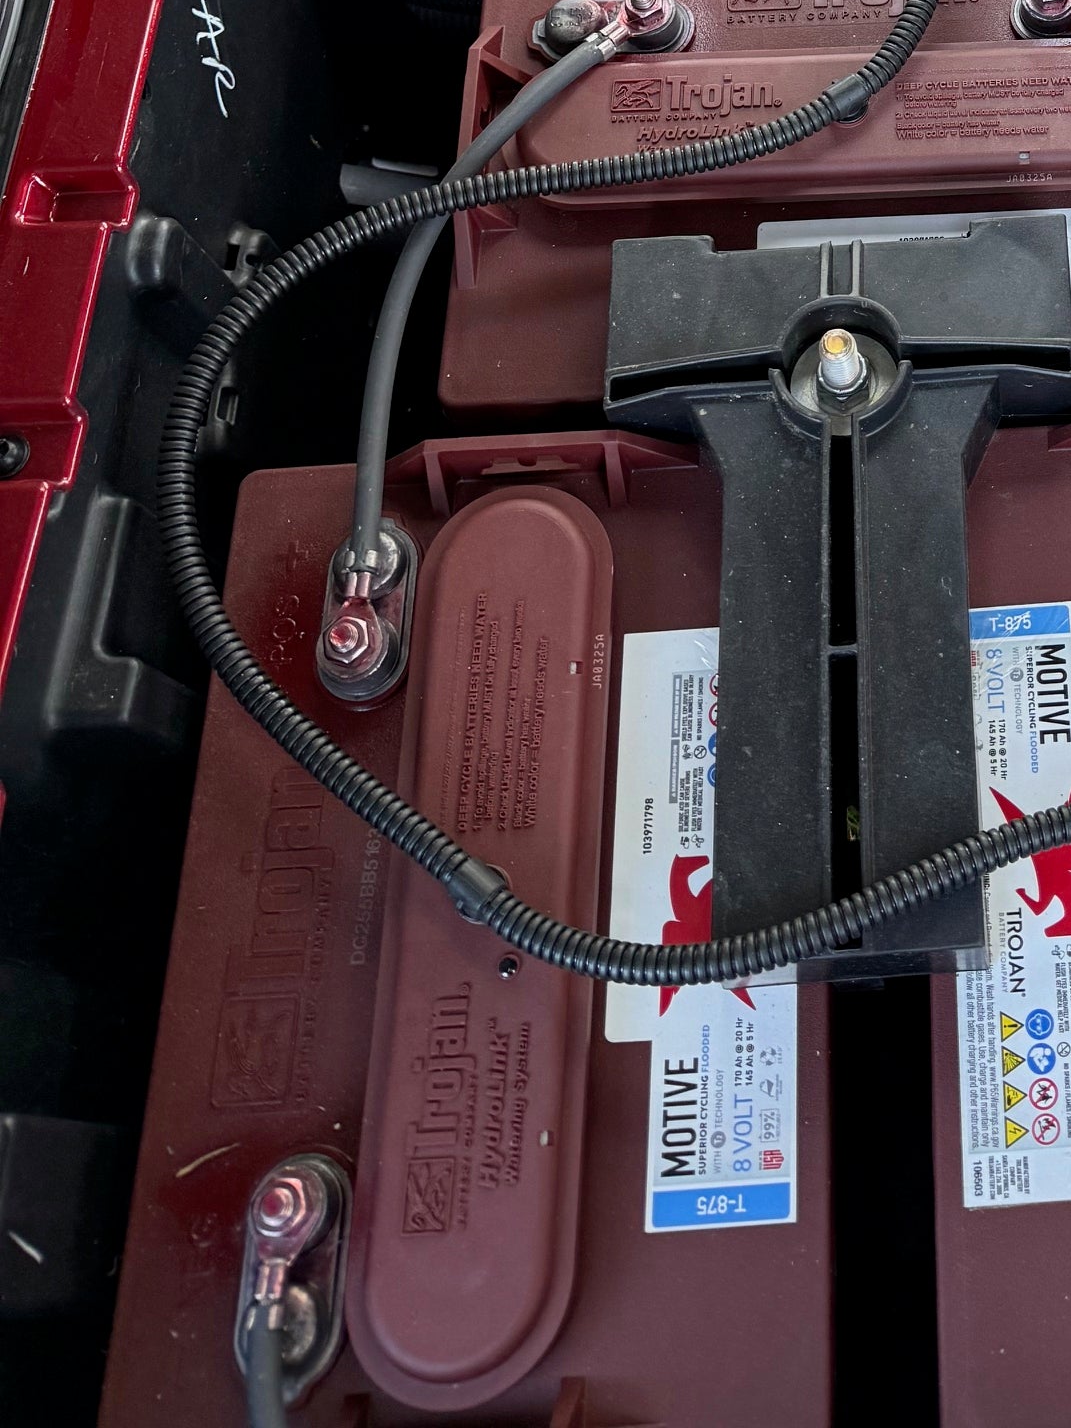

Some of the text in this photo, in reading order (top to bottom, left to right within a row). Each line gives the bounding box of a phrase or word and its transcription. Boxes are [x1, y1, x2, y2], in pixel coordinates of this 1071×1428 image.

[727, 10, 884, 25] BATTERY COMPANY
[666, 73, 773, 116] Trojan
[896, 82, 922, 91] DEEP
[926, 81, 959, 89] CYCLE
[963, 79, 1018, 88] BATTERIES
[1021, 77, 1047, 87] NEED
[610, 113, 717, 123] BATTERY COMPANY
[897, 127, 1050, 140] White color battery needs water
[269, 594, 299, 666] POS
[988, 611, 1031, 632] T-875
[986, 649, 1005, 713] 8 VOLT
[1012, 647, 1023, 734] WITH TECHNOLOGY
[1035, 644, 1071, 745] MOTIVE
[458, 592, 487, 830] DEEP CYCLE BATTERIES NEED WATER
[483, 686, 493, 713] MUST
[1027, 691, 1036, 729] CYCLING
[524, 637, 549, 826] White color battery needs water
[989, 736, 996, 746] Ah
[999, 736, 1006, 746] Ah
[999, 748, 1006, 756] @
[1000, 759, 1007, 768] 20
[1029, 731, 1038, 773] FLOODED
[990, 766, 997, 776] Hr
[1001, 771, 1007, 780] Hr
[643, 798, 654, 854] 103971798
[1006, 908, 1025, 993] TROJAN
[1000, 952, 1008, 993] COMPANY
[967, 1002, 975, 1019] other
[747, 1022, 754, 1032] Hr
[966, 1020, 977, 1043] battery
[734, 1017, 743, 1086] 170 Ah @ 20 Hr
[746, 1044, 754, 1052] @
[746, 1055, 754, 1067] Ah
[967, 1045, 977, 1073] charging
[405, 995, 477, 1155] Trojan
[745, 1070, 753, 1086] 145
[970, 1075, 978, 1087] and
[976, 983, 990, 1147] combustible gases. Use, charge and maintain only
[986, 984, 999, 1148] Wash hands after handling. www.P65Warnings.ca.gov
[478, 1033, 510, 1188] HydroLink
[504, 1021, 530, 1185] Watering System
[699, 1024, 710, 1175] SUPERIOR CYCLING FLOODED
[970, 1090, 979, 1107] other
[661, 1057, 699, 1178] MOTIVE
[714, 1069, 724, 1173] WITH TECHNOLOGY
[733, 1094, 753, 1172] 8 VOLT
[763, 1112, 776, 1140] 99%
[971, 1109, 980, 1151] instructions.
[762, 1149, 784, 1170] USA
[973, 1160, 983, 1196] 106503
[696, 1194, 746, 1215] T-875
